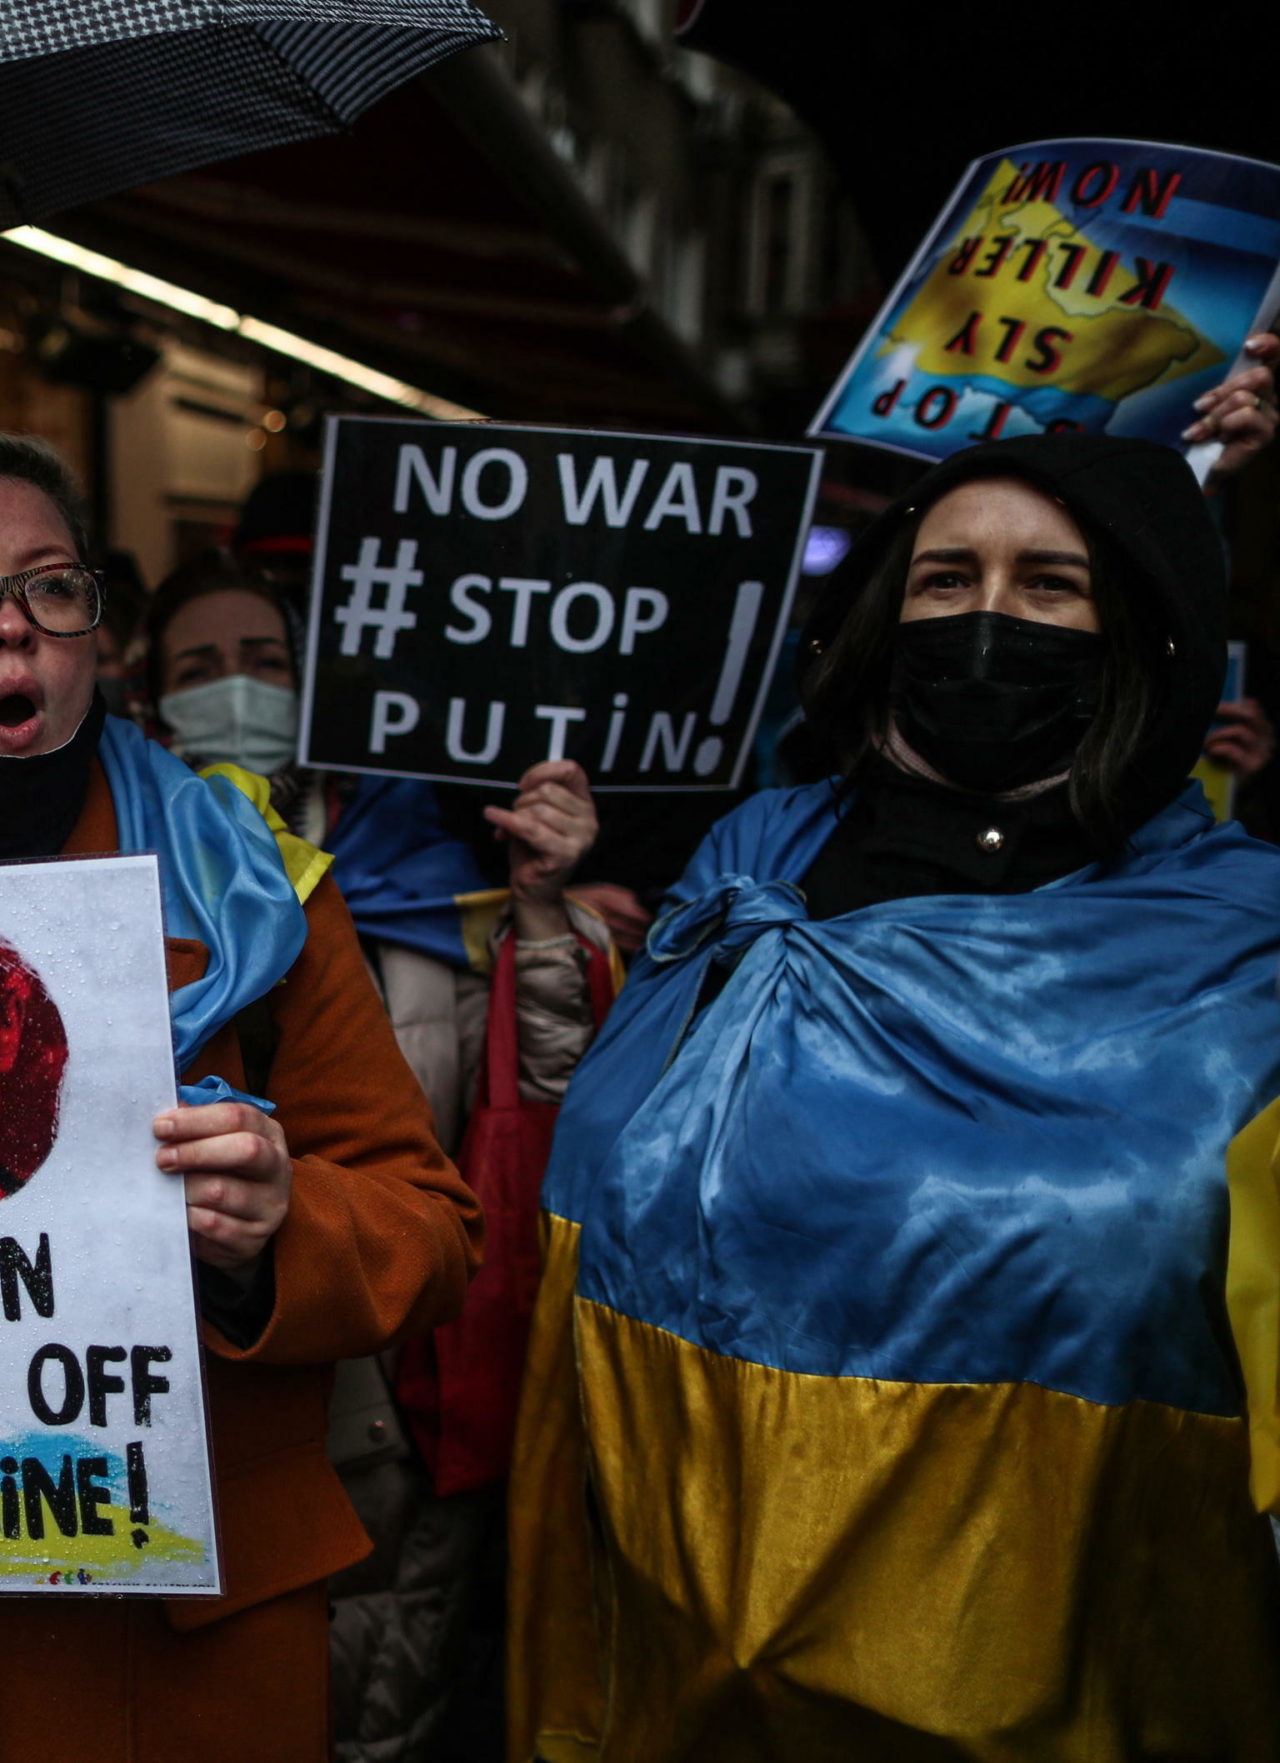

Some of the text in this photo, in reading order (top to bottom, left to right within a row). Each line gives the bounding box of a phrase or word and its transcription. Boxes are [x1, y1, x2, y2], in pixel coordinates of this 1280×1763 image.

[948, 236, 1176, 310] KILLER
[942, 310, 1074, 376] SLY
[873, 380, 1086, 442] TOP
[392, 442, 759, 539] NO WAR
[27, 1342, 173, 1429] OFF
